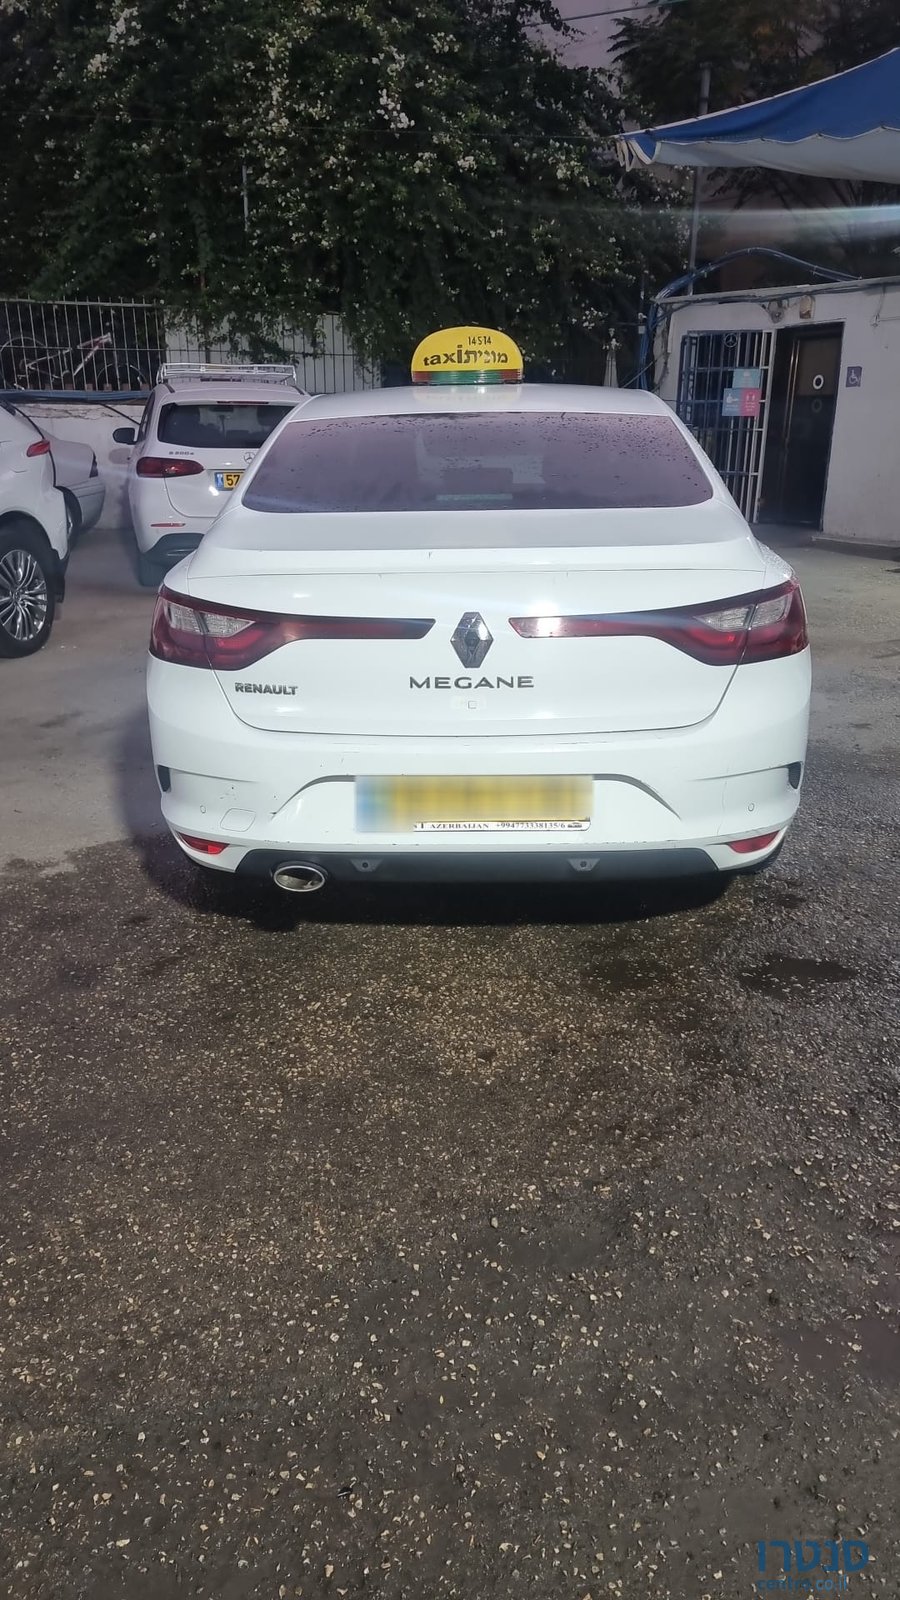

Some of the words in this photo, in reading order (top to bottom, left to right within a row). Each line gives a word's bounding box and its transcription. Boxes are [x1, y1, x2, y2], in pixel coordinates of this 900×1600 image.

[423, 344, 463, 366] taxi
[463, 349, 508, 364] מונית
[234, 682, 299, 696] RENAULT
[409, 675, 535, 690] MEGANE
[430, 822, 490, 830] AZERBAIJAN
